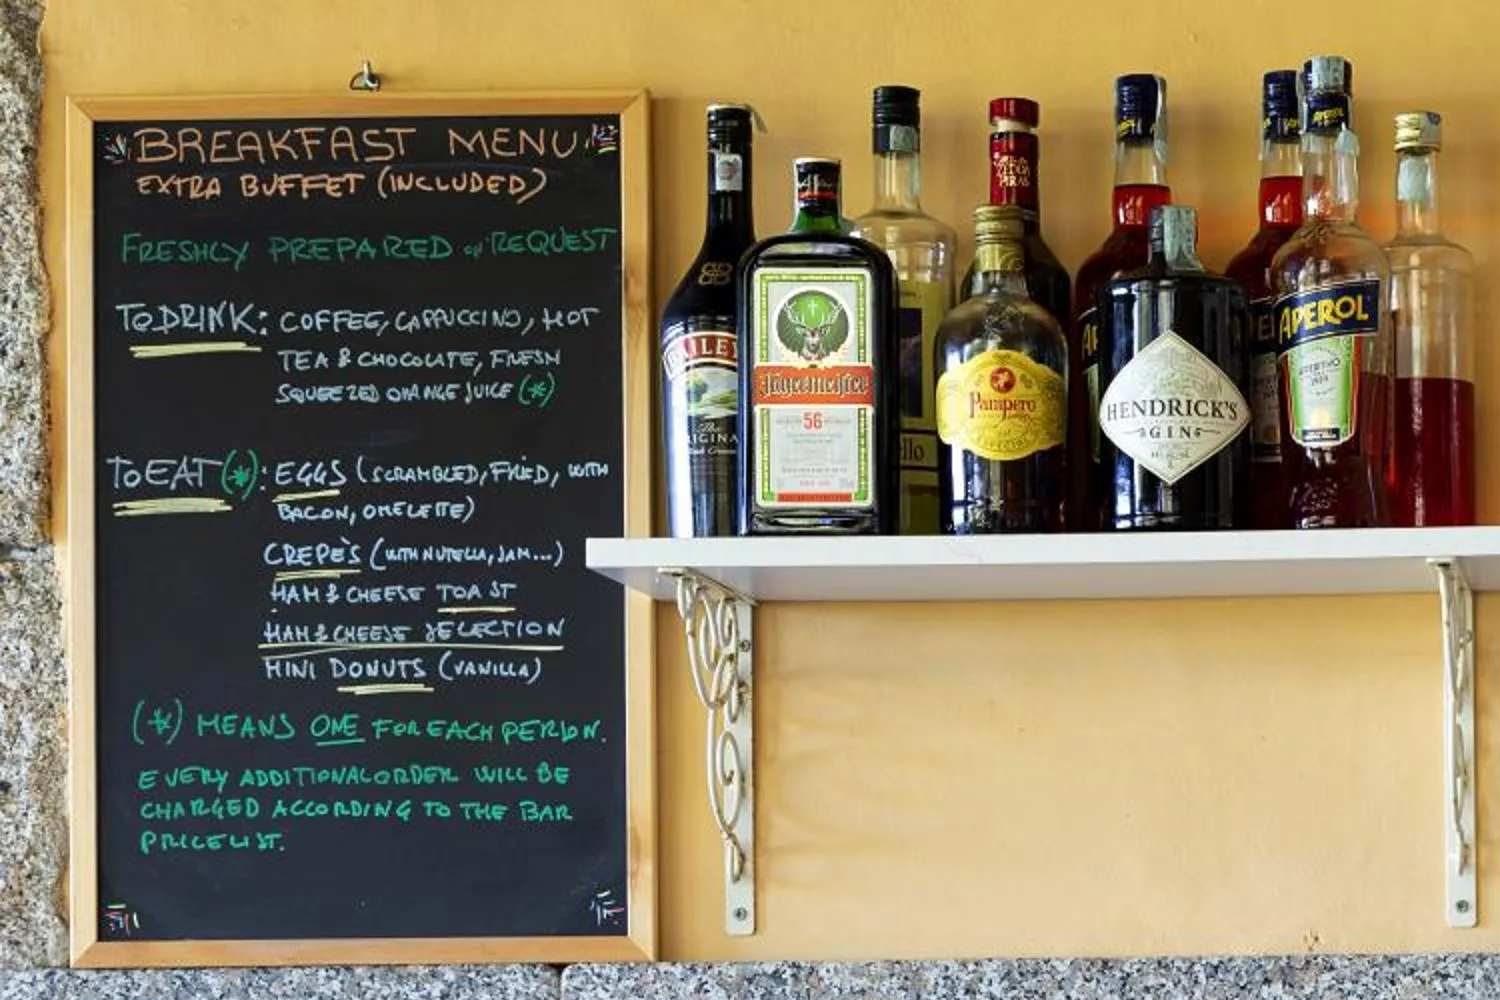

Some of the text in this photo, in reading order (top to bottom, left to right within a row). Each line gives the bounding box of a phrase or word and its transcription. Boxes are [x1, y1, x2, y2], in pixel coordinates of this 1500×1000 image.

[134, 126, 577, 164] BREAKFAST MENU
[136, 165, 547, 204] EXTRA BUFFET (INCLUDED)
[268, 233, 453, 262] PREPARED
[486, 225, 617, 257] REQUEST
[542, 306, 600, 332] HOT
[1279, 294, 1370, 345] APEROL
[277, 350, 329, 372] TEA
[337, 347, 352, 369] &
[490, 348, 561, 369] FRESH
[275, 383, 379, 404] SQUEEZED
[386, 382, 461, 402] ORANGE
[464, 380, 515, 404] JUICE
[969, 391, 1037, 420] Pampero
[1107, 398, 1239, 422] HENDRICK'S
[803, 411, 823, 430] 56
[1149, 426, 1192, 440] GIN
[275, 460, 348, 487] EGGS
[567, 461, 609, 478] WITH
[270, 580, 518, 604] HAM & CHEESE TOAST
[263, 621, 309, 643] HAM
[333, 624, 413, 643] CHEESE
[425, 617, 566, 643] SELECTION
[264, 650, 541, 685] MINI DONUTS (VANILLA)
[197, 713, 296, 739] MEANS
[309, 713, 361, 737] ONE
[371, 719, 421, 740] FOR
[426, 719, 493, 742] EACH
[138, 766, 229, 793] EVERY
[473, 766, 528, 784] WILL
[536, 761, 570, 784] BE
[140, 798, 573, 822] CHARGED ACCORDING TO THE BAR
